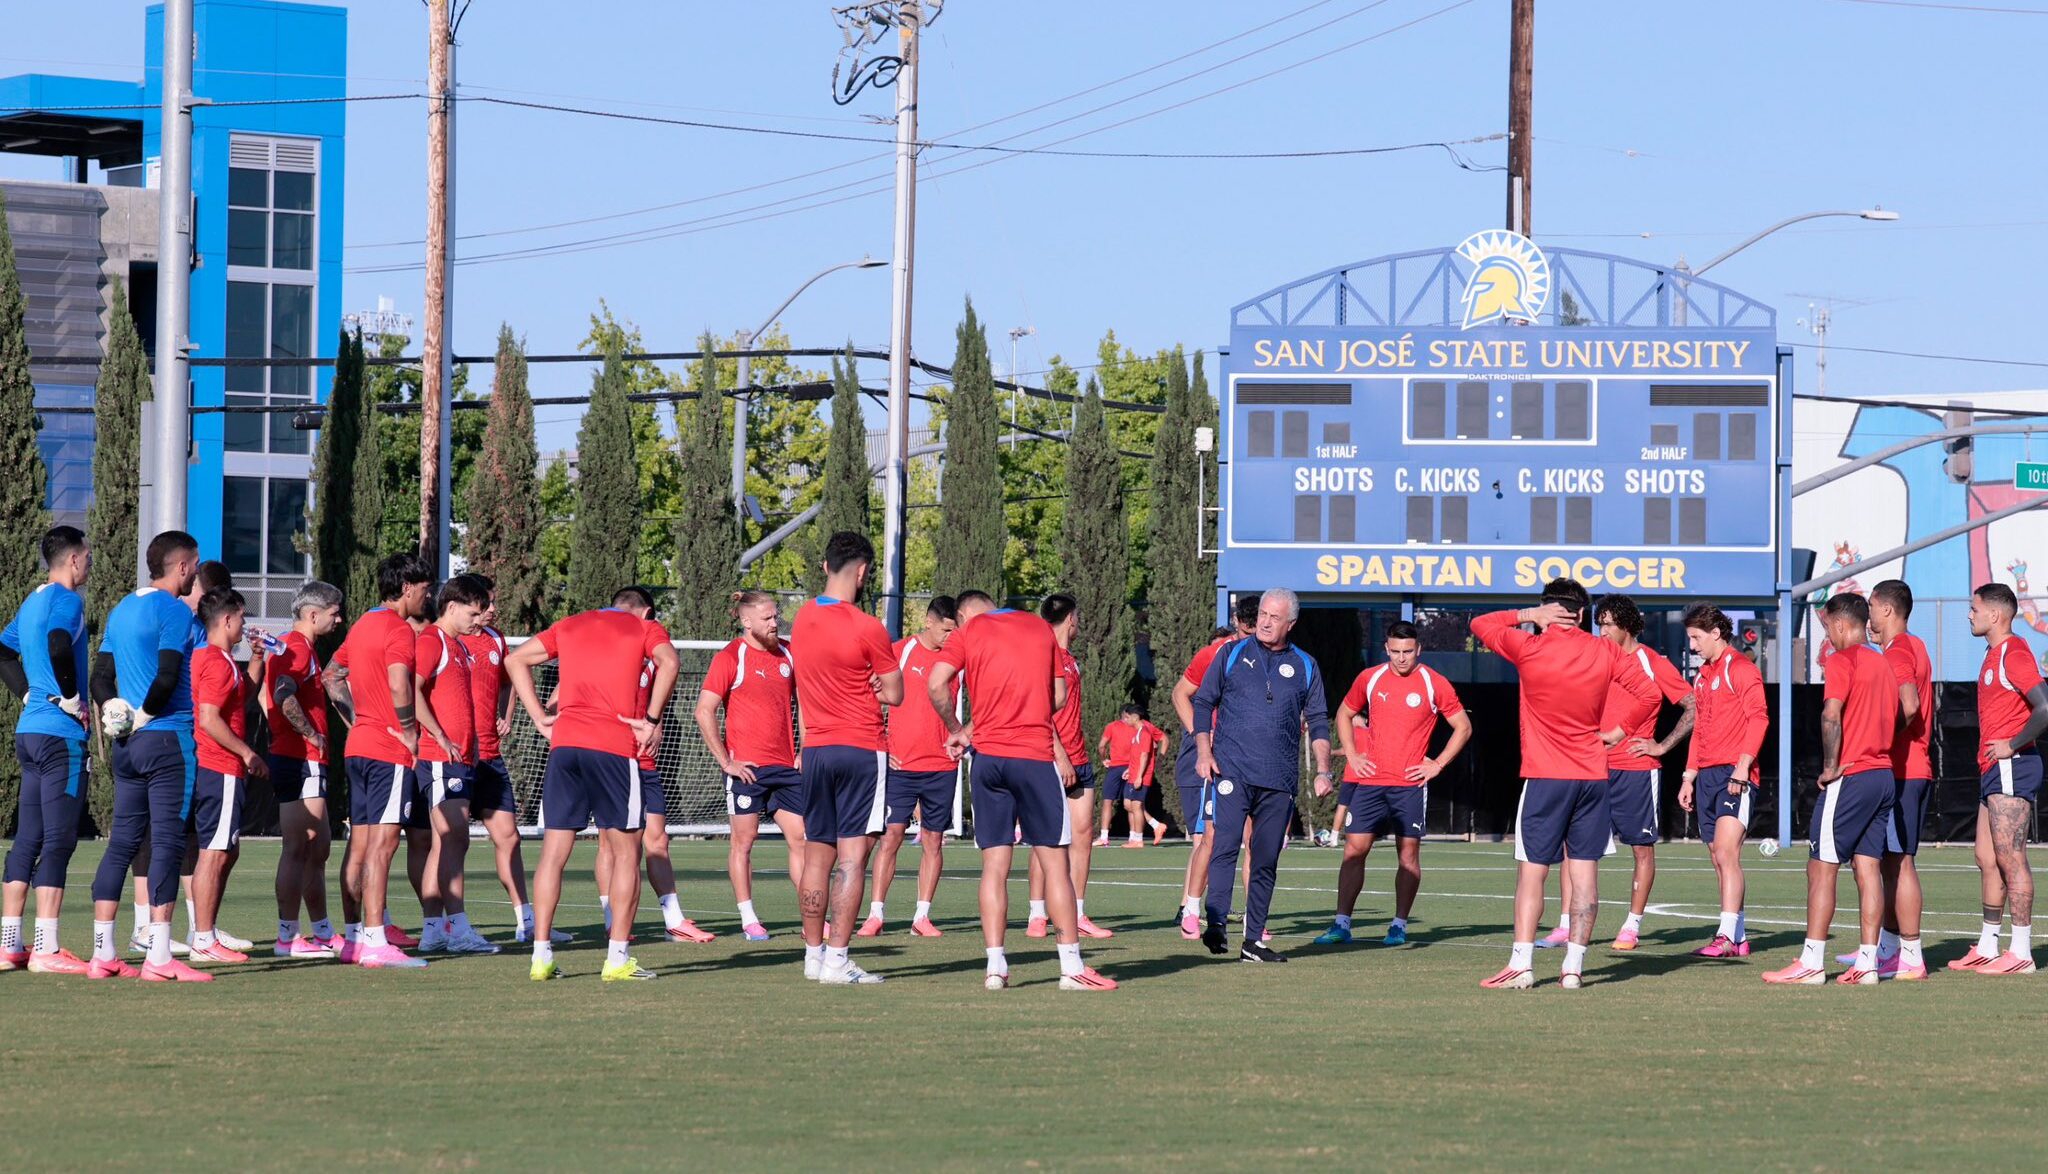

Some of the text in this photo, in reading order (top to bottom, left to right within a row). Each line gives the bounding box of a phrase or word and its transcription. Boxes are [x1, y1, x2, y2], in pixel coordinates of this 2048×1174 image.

[1254, 333, 1751, 372] SAN JOSÉ STATE UNIVERSITY
[1468, 373, 1532, 381] DAKTRONICS
[1315, 445, 1358, 458] 1st HALF
[1640, 447, 1687, 460] 2nd HALF
[1294, 467, 1374, 492] SHOTS
[1395, 467, 1480, 492] C. KICKS
[1518, 468, 1604, 493] C. KICKS
[1624, 468, 1705, 494] SHOTS
[2028, 469, 2048, 484] 10t
[1316, 554, 1685, 588] SPARTAN SOCCER
